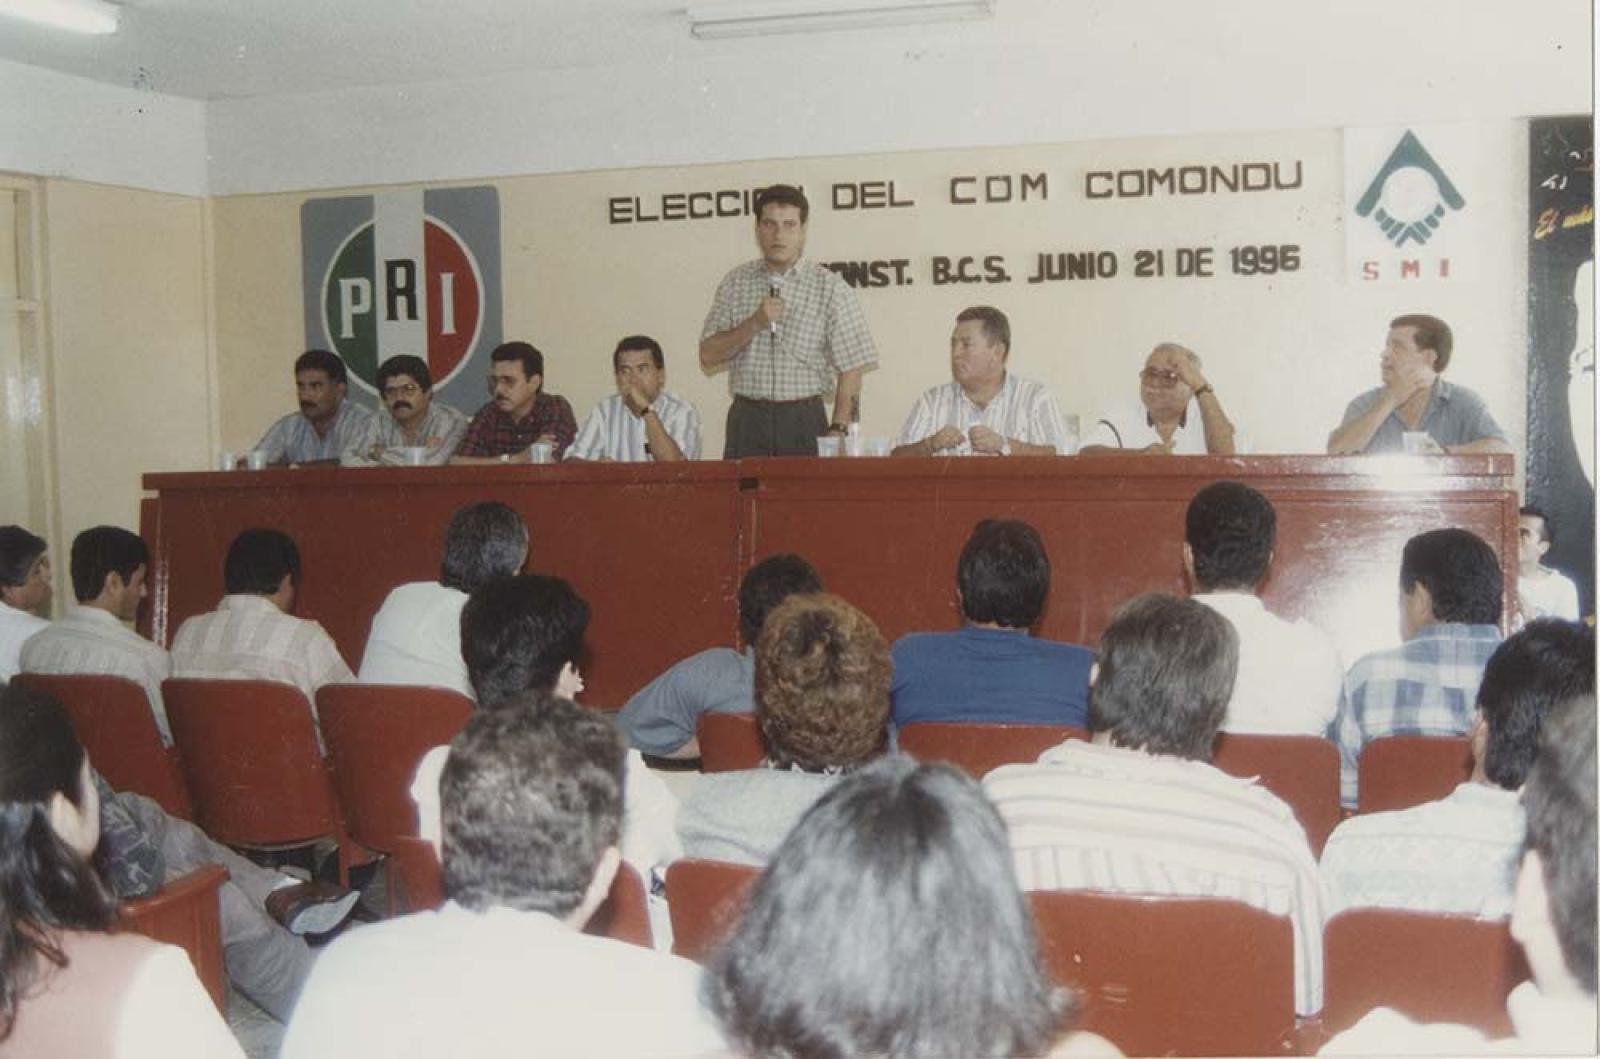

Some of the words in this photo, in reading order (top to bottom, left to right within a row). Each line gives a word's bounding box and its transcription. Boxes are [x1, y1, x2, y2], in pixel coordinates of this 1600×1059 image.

[609, 186, 804, 224] ELECCI
[831, 181, 914, 211] DEL
[1085, 160, 1302, 199] COMONDU
[932, 256, 1012, 285] B.C.S.
[1027, 251, 1118, 284] JUNIO
[1134, 249, 1164, 277] 21
[1176, 247, 1214, 277] DE
[1229, 245, 1300, 275] 1996
[338, 258, 457, 339] PRI
